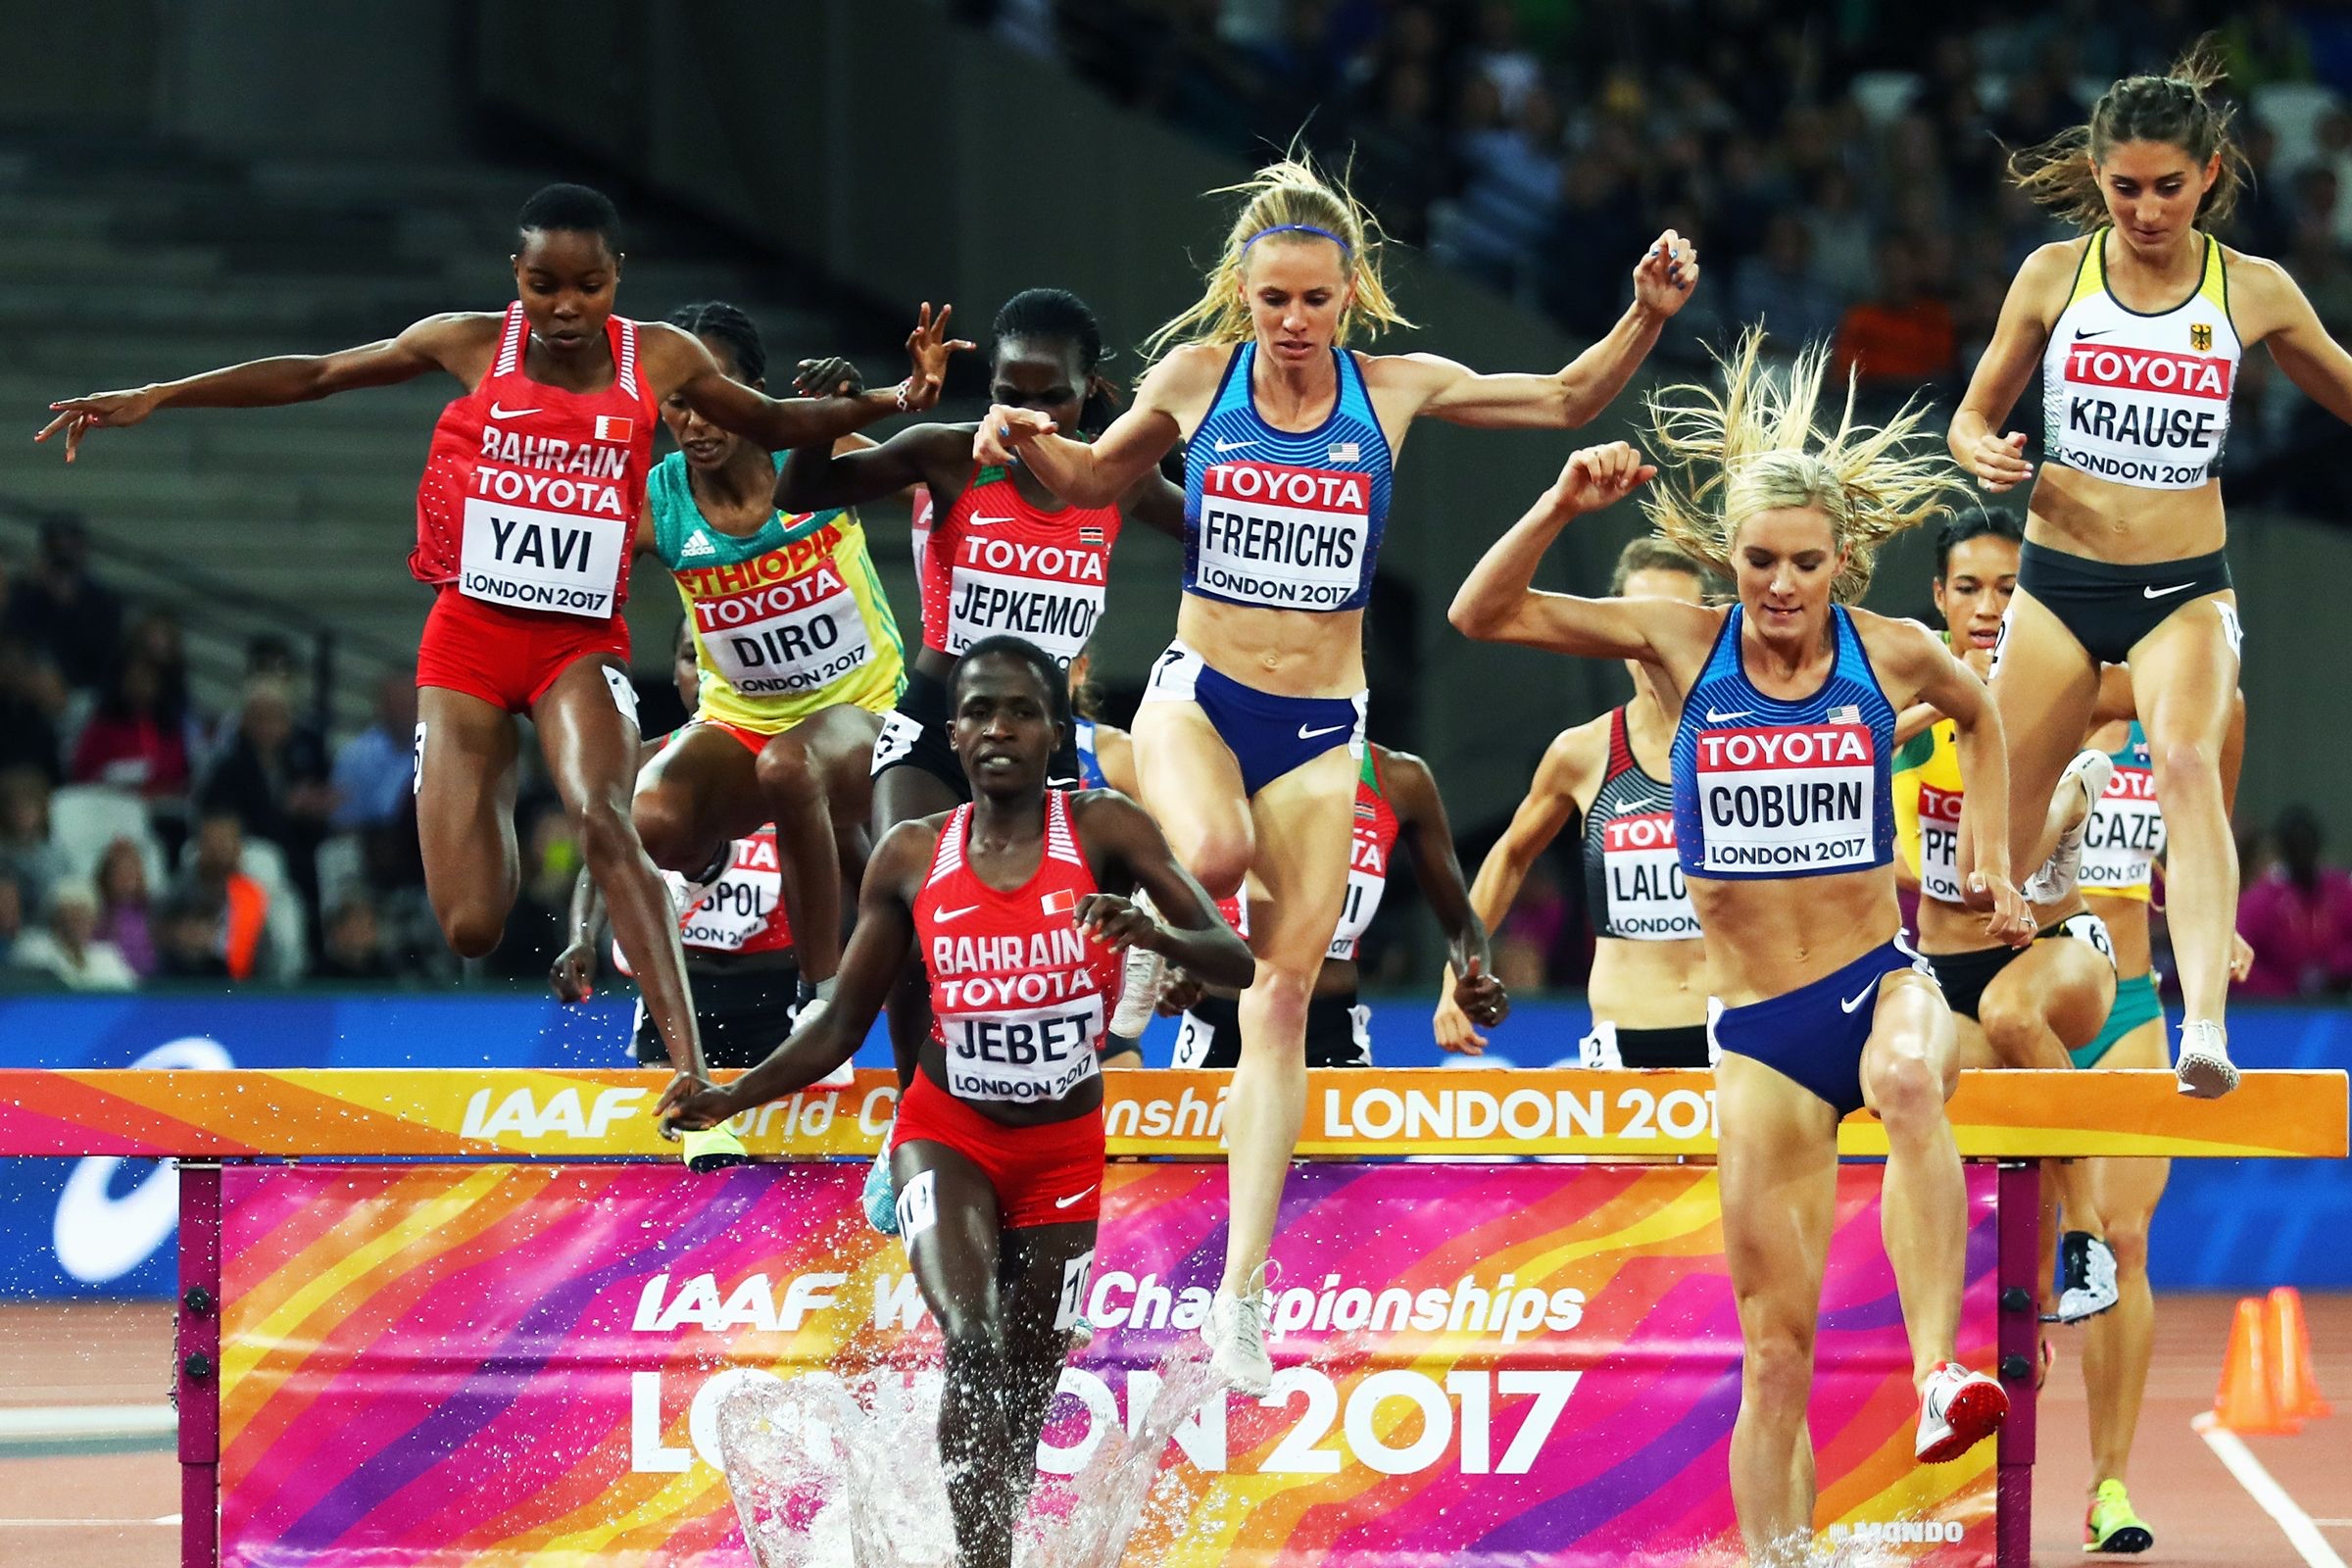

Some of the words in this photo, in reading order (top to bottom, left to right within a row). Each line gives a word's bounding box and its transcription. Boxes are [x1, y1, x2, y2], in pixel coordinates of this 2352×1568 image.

[2074, 350, 2223, 394] TOYOTA
[2070, 396, 2216, 448] KRAUSE
[480, 425, 630, 480] BAHRAIN
[2065, 449, 2157, 481] LONDON
[476, 466, 622, 515] TOYOTA
[1210, 466, 1363, 509] TOYOTA
[490, 517, 593, 573] YAVI
[673, 522, 842, 596] ETHIOPIA
[965, 535, 1103, 581] TOYOTA
[1205, 510, 1356, 568] FRERICHS
[466, 572, 554, 604] LONDON
[556, 589, 608, 611] 2017
[694, 568, 841, 627] TOYOTA
[1203, 566, 1296, 601] LONDON
[1299, 584, 1351, 605] 2017
[731, 613, 838, 667] DIRO
[823, 644, 866, 679] 2017
[1701, 732, 1867, 766] TOYOTA
[1709, 781, 1862, 828] COBURN
[2105, 770, 2156, 798] OTA
[1608, 818, 1678, 847] TOY
[1711, 845, 1811, 864] LONDON
[1814, 838, 1866, 861] 2017
[2084, 811, 2162, 850] CAZE
[1614, 862, 1688, 902] LALO
[1927, 875, 1961, 896] LON
[2079, 865, 2122, 880] DON
[682, 927, 724, 942] DON
[933, 927, 1086, 976] BAHRAIN
[940, 970, 1095, 1007] TOYOTA
[956, 1010, 1093, 1064] JEBET
[955, 1074, 1052, 1098] LONDON
[1055, 1054, 1092, 1094] 2017
[461, 1087, 649, 1139] IAAF
[731, 1091, 839, 1137] orld
[1325, 1088, 1604, 1140] LONDON
[1617, 1088, 1719, 1140] 201
[631, 1272, 849, 1332] IAAF
[1087, 1270, 1586, 1344] Chapionships
[1257, 1366, 1584, 1475] 2017
[1854, 1521, 1964, 1544] MONDO
